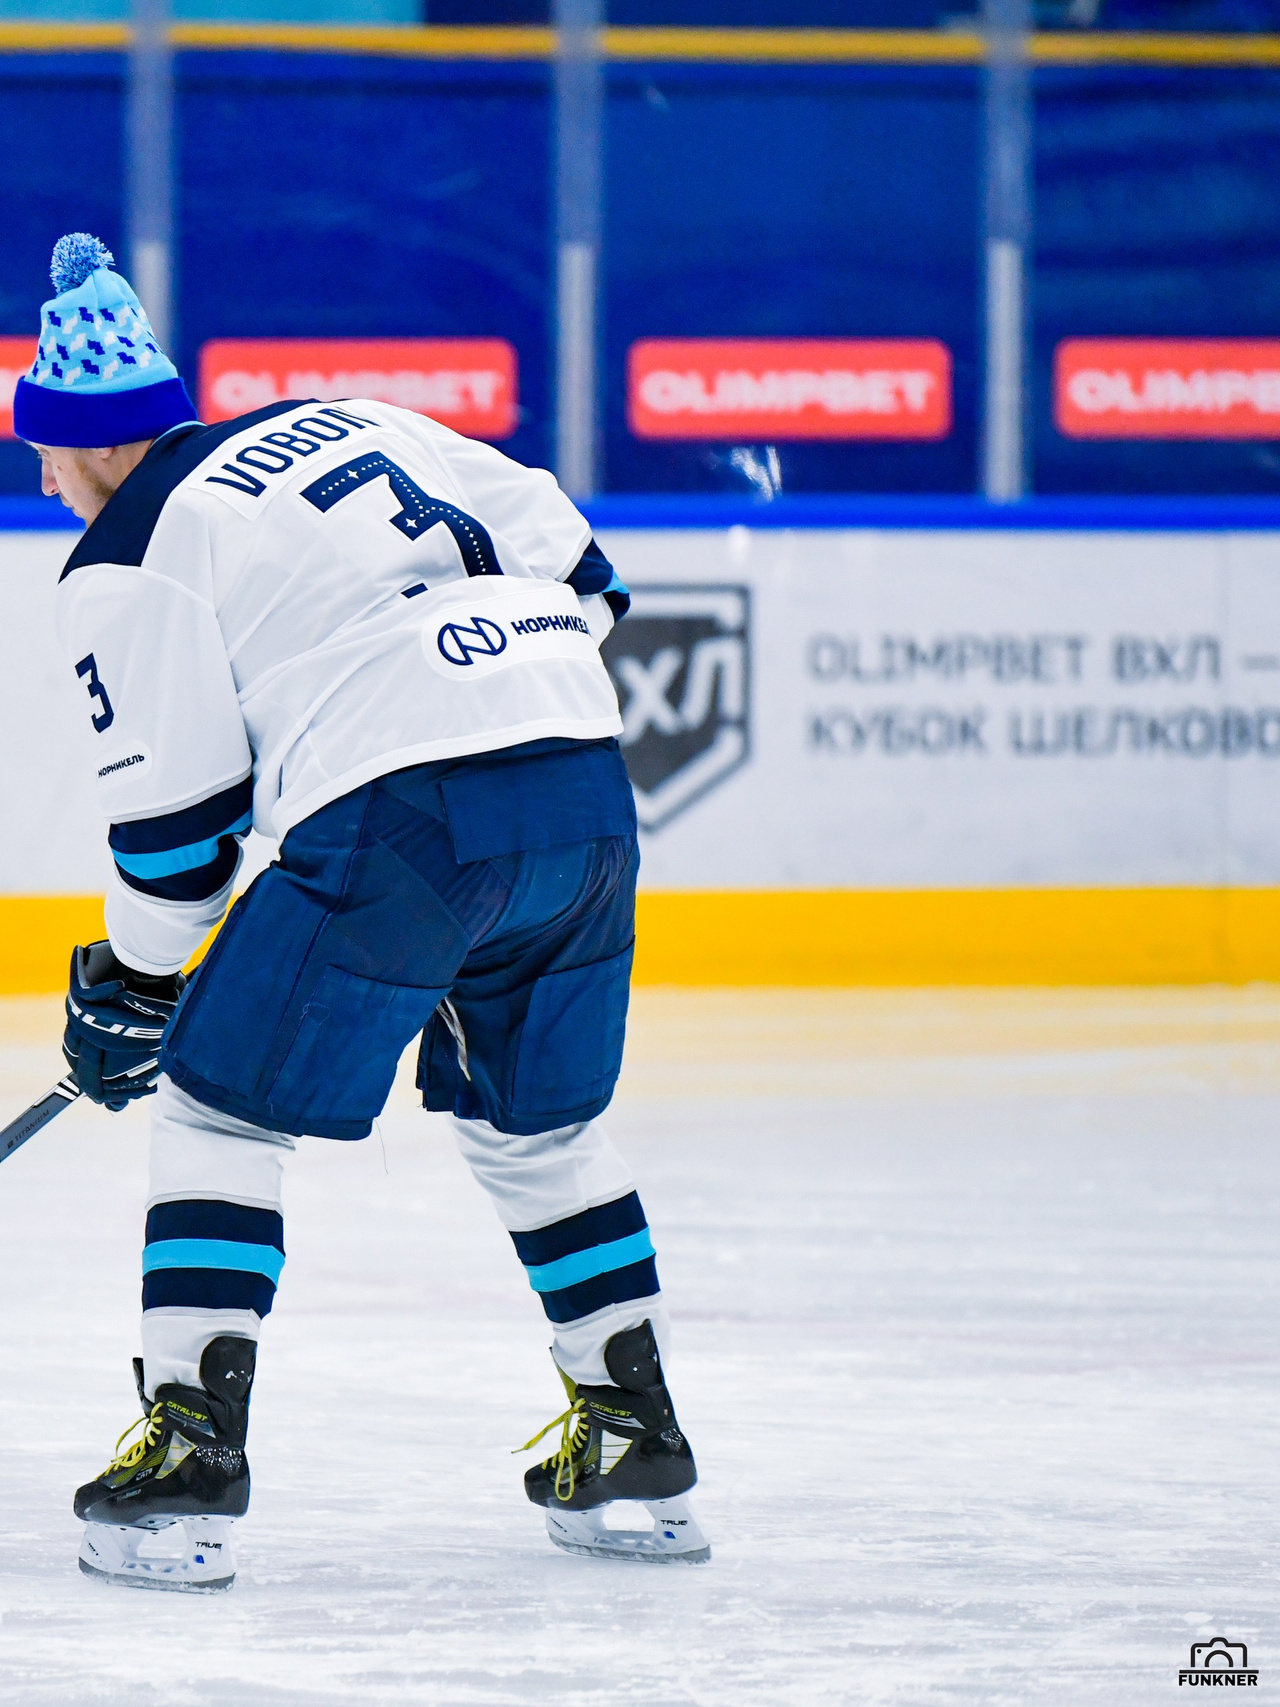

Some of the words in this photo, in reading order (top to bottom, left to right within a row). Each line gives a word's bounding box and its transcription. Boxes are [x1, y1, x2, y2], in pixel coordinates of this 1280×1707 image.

[641, 370, 933, 414] OLIMPBET
[1068, 369, 1280, 414] OLIMPB
[299, 451, 504, 598] 3
[808, 634, 1088, 683] OLIMPBET
[1113, 632, 1222, 685] ВХЛ
[75, 652, 114, 733] 3
[616, 637, 743, 748] ХЛ
[808, 704, 988, 757] КУБОК
[1008, 705, 1280, 758] ШЕЛКОВО
[98, 754, 145, 778] НОРНИКЕЛЬ
[167, 1401, 208, 1421] CATALYST
[195, 1541, 222, 1550] TRUE
